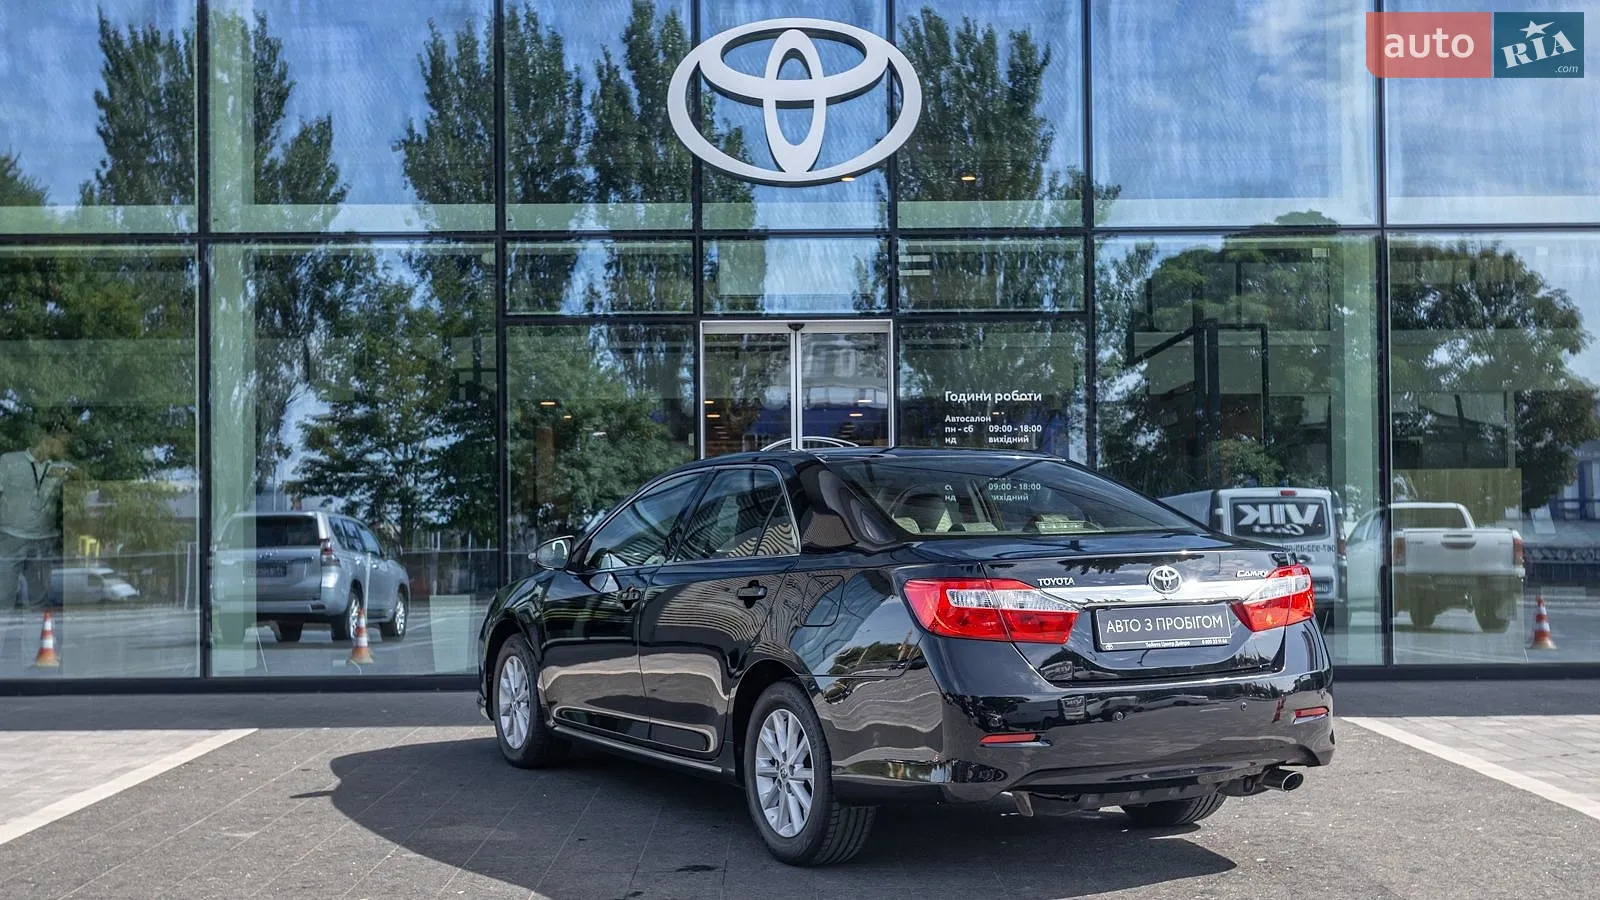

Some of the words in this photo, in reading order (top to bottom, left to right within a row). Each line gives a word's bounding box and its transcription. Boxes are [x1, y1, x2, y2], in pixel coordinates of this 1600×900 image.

[945, 391, 992, 403] Години
[995, 390, 1042, 402] роботи
[945, 415, 991, 423] Автосалон
[988, 425, 1012, 433] 09:00
[1020, 425, 1042, 433] 18:00
[945, 437, 957, 445] нд
[988, 435, 1029, 444] вихідний
[988, 483, 1012, 491] 09:00
[1019, 483, 1041, 491] 18:00
[1237, 570, 1269, 578] CAMRY
[1036, 577, 1076, 587] TOYOTA
[1106, 619, 1141, 634] АВТО
[1156, 615, 1224, 631] ПРОБІГОМ
